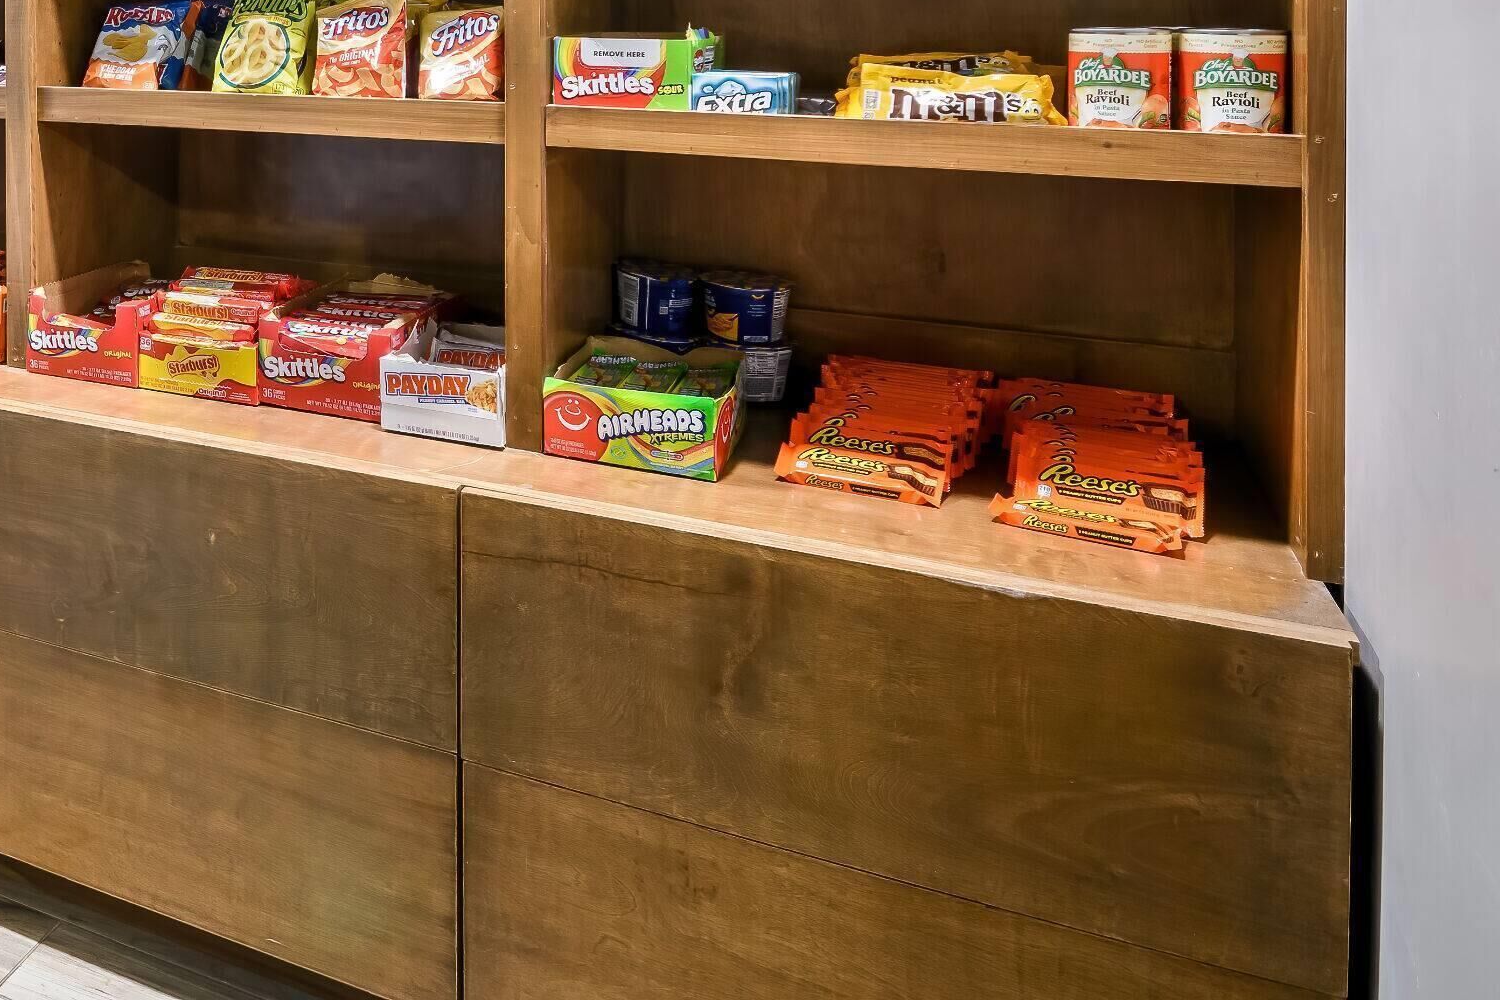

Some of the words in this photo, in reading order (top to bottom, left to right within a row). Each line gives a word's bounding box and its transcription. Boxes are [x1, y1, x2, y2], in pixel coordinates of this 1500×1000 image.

[323, 7, 389, 40] Fritos
[431, 14, 500, 56] Fritos
[339, 49, 378, 62] ORIGINA
[593, 50, 624, 58] REMOVE
[1080, 58, 1100, 69] Chef
[1203, 59, 1230, 70] Chef
[561, 72, 655, 98] Skittles
[890, 75, 943, 85] peanut
[1075, 69, 1150, 87] BOYARDEE
[1195, 70, 1278, 89] BOYARDEE
[658, 84, 684, 95] SOUR
[697, 92, 772, 112] Extra
[1086, 94, 1130, 106] Ravioli
[1212, 97, 1260, 109] Ravioli
[172, 302, 228, 319] Starburst
[30, 329, 98, 352] Skittles
[141, 338, 151, 346] 36
[30, 359, 38, 368] 36
[168, 355, 218, 375] Starburst
[264, 355, 345, 381] Skittles
[263, 388, 273, 398] 36
[386, 373, 470, 396] PAYDAY
[598, 409, 705, 440] AIRHEADS
[651, 432, 704, 444] XTREMES
[808, 427, 895, 455] Reese's
[798, 447, 886, 472] Reese's
[805, 474, 844, 490] Reese's
[1040, 463, 1141, 496] Reese's
[1107, 496, 1122, 504] CUPS
[1023, 514, 1068, 533] Reese's
